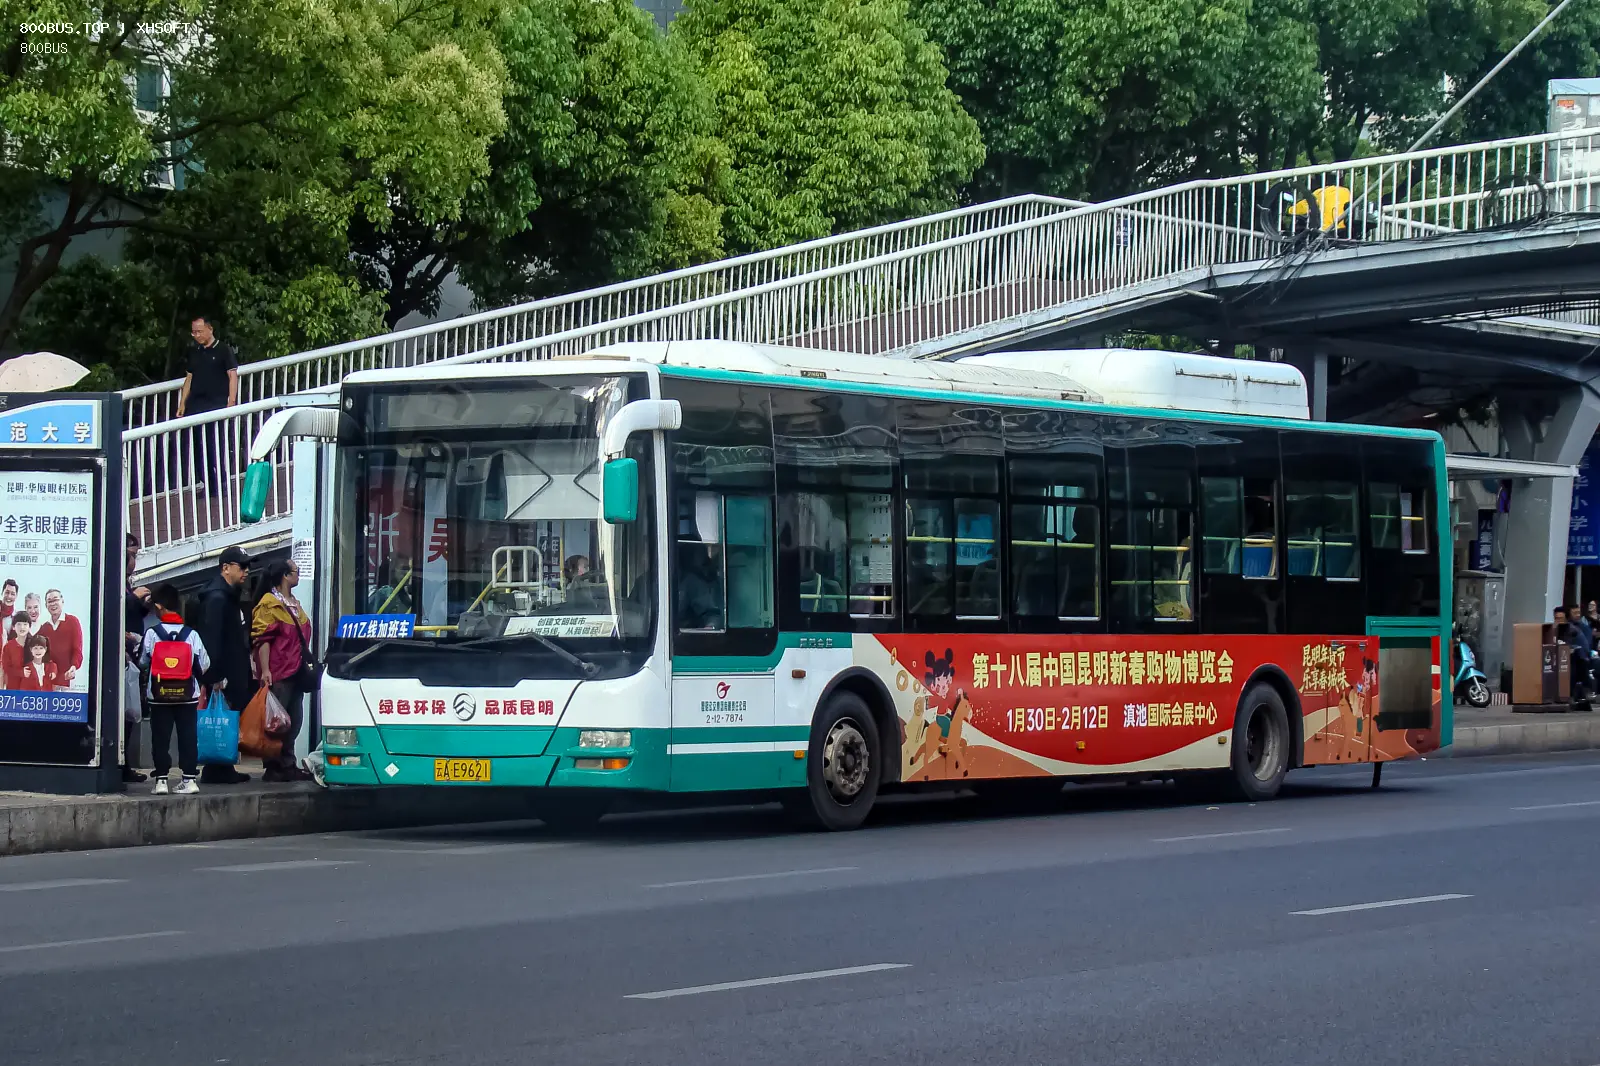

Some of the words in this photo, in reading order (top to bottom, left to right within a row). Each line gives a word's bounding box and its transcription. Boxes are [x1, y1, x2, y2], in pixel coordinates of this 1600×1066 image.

[10, 421, 92, 443] 范大学
[0, 514, 88, 536] 全家眼健康
[973, 650, 1234, 689] 第十八届中国昆明新春购物博览会
[52, 697, 82, 713] 9999
[379, 699, 447, 715] 绿色环保
[484, 699, 554, 715] 品质昆明
[1006, 705, 1108, 733] 1月30日-2月12日
[1123, 702, 1218, 728] 滇池国际会展中心
